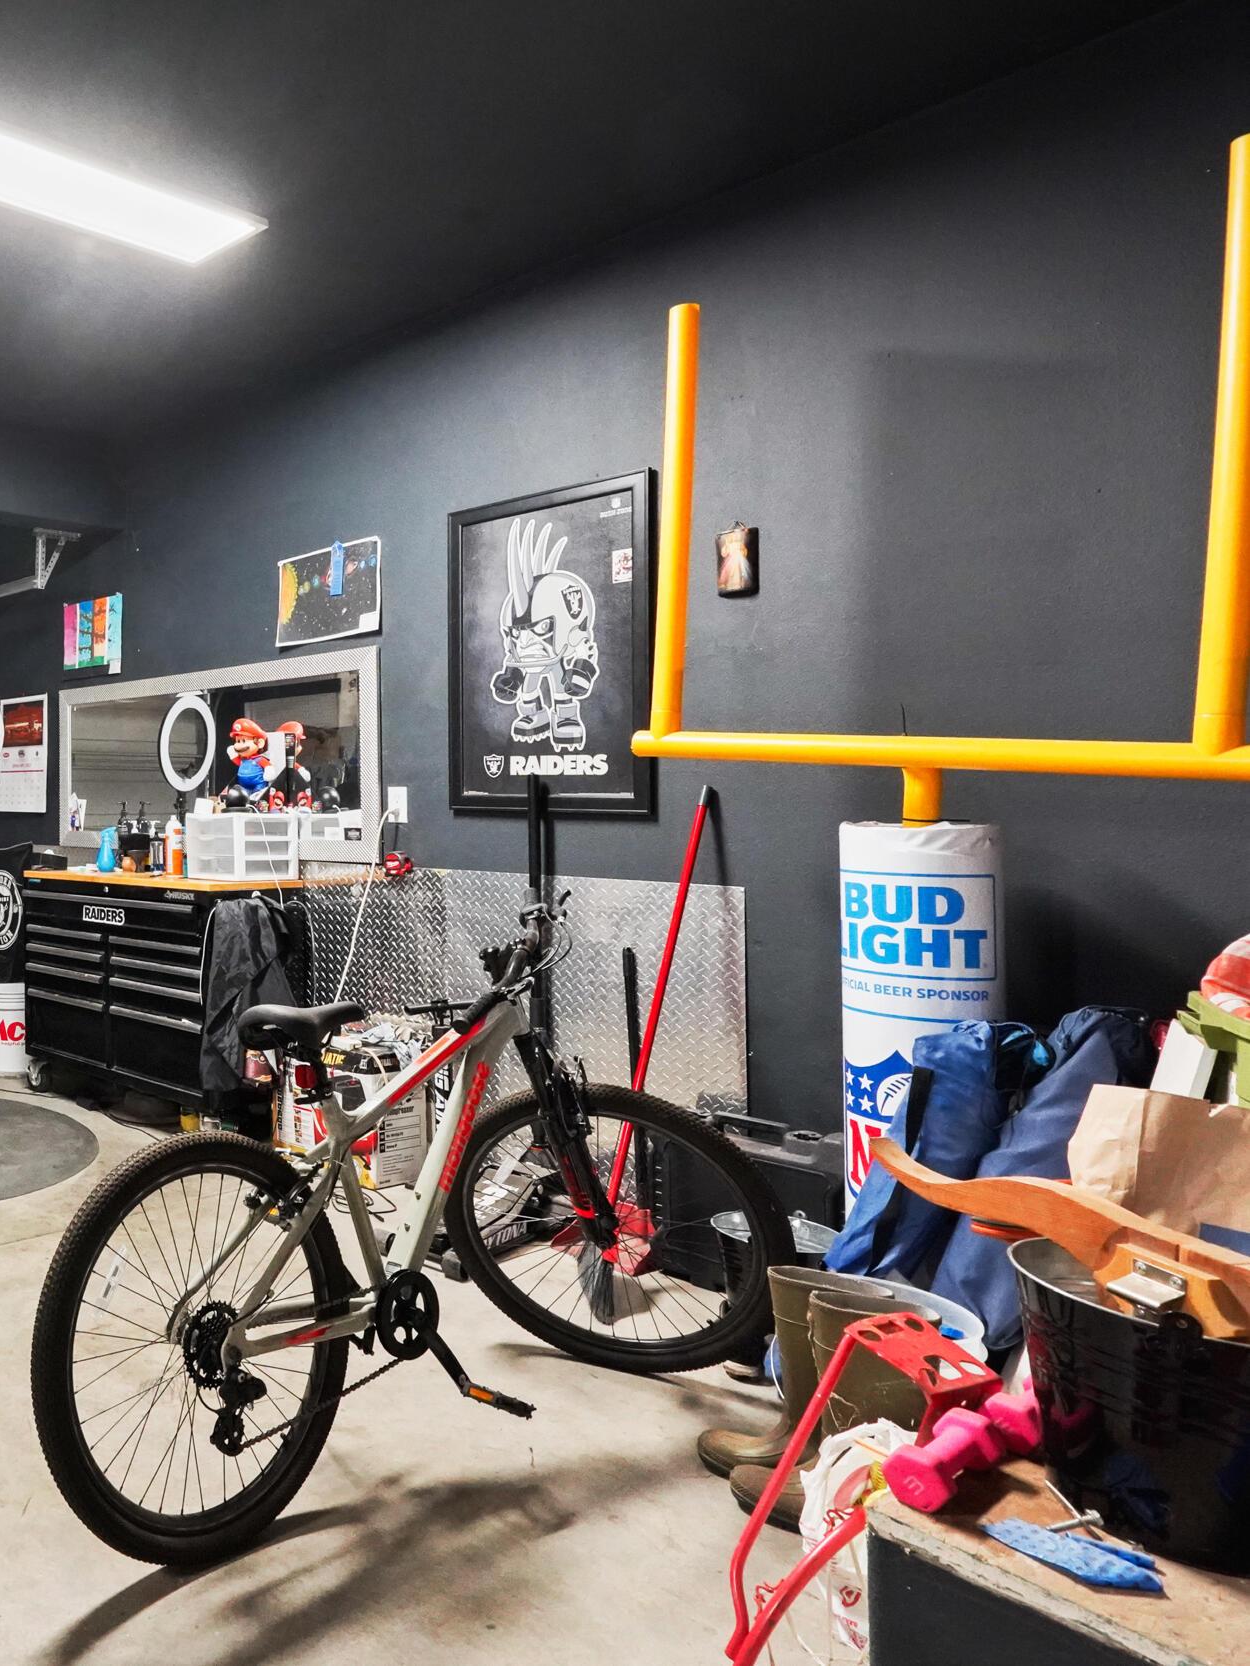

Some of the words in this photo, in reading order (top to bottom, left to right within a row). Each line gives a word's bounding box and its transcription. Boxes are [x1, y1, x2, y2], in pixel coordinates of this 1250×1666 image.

[510, 754, 609, 776] RAIDERS
[845, 882, 965, 925] BUD
[84, 906, 124, 924] RAIDERS
[874, 984, 912, 998] BEER
[917, 988, 989, 1001] SPONSOR
[438, 1062, 490, 1193] mongoose
